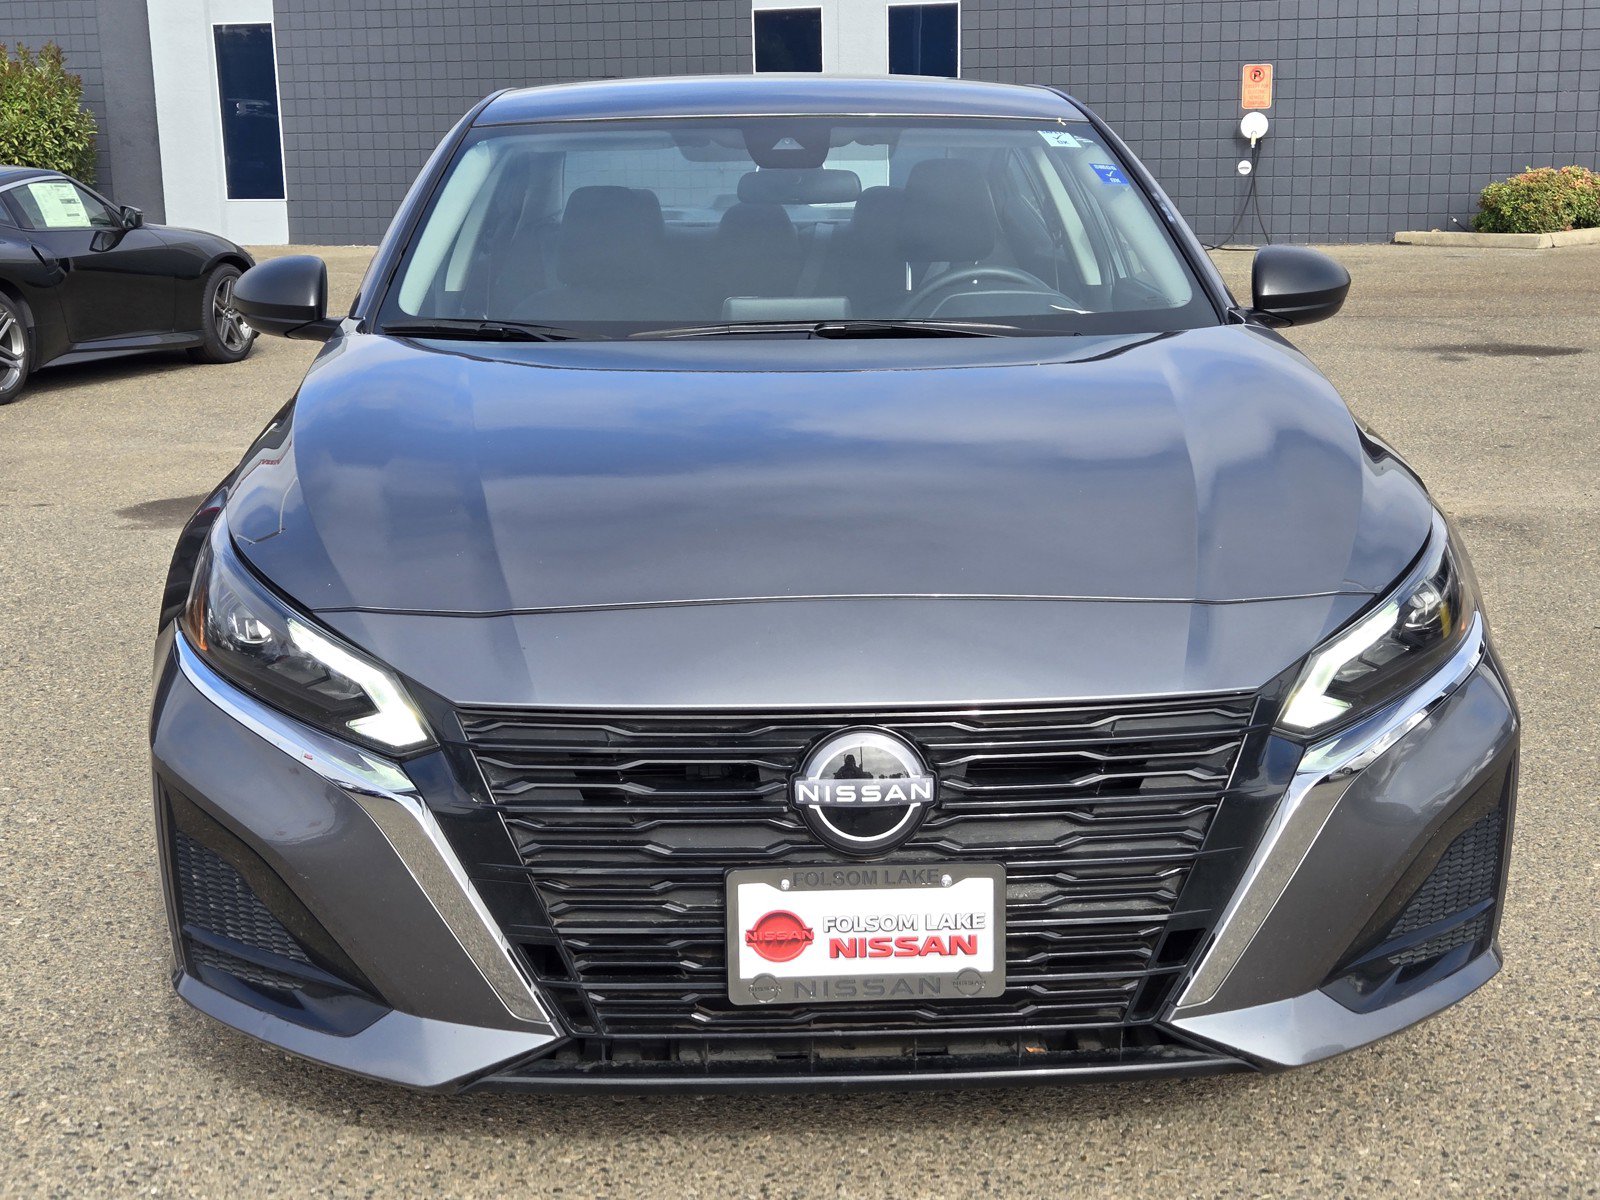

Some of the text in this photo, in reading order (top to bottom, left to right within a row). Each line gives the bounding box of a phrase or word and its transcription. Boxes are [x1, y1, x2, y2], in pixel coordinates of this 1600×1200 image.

[798, 781, 931, 802] NISSAN
[792, 868, 940, 887] FOLSOM LAKE
[823, 912, 986, 933] FOLSOM LAKE
[745, 927, 815, 943] NISSAN
[829, 934, 978, 959] NISSAN
[793, 977, 942, 999] NISSAN
